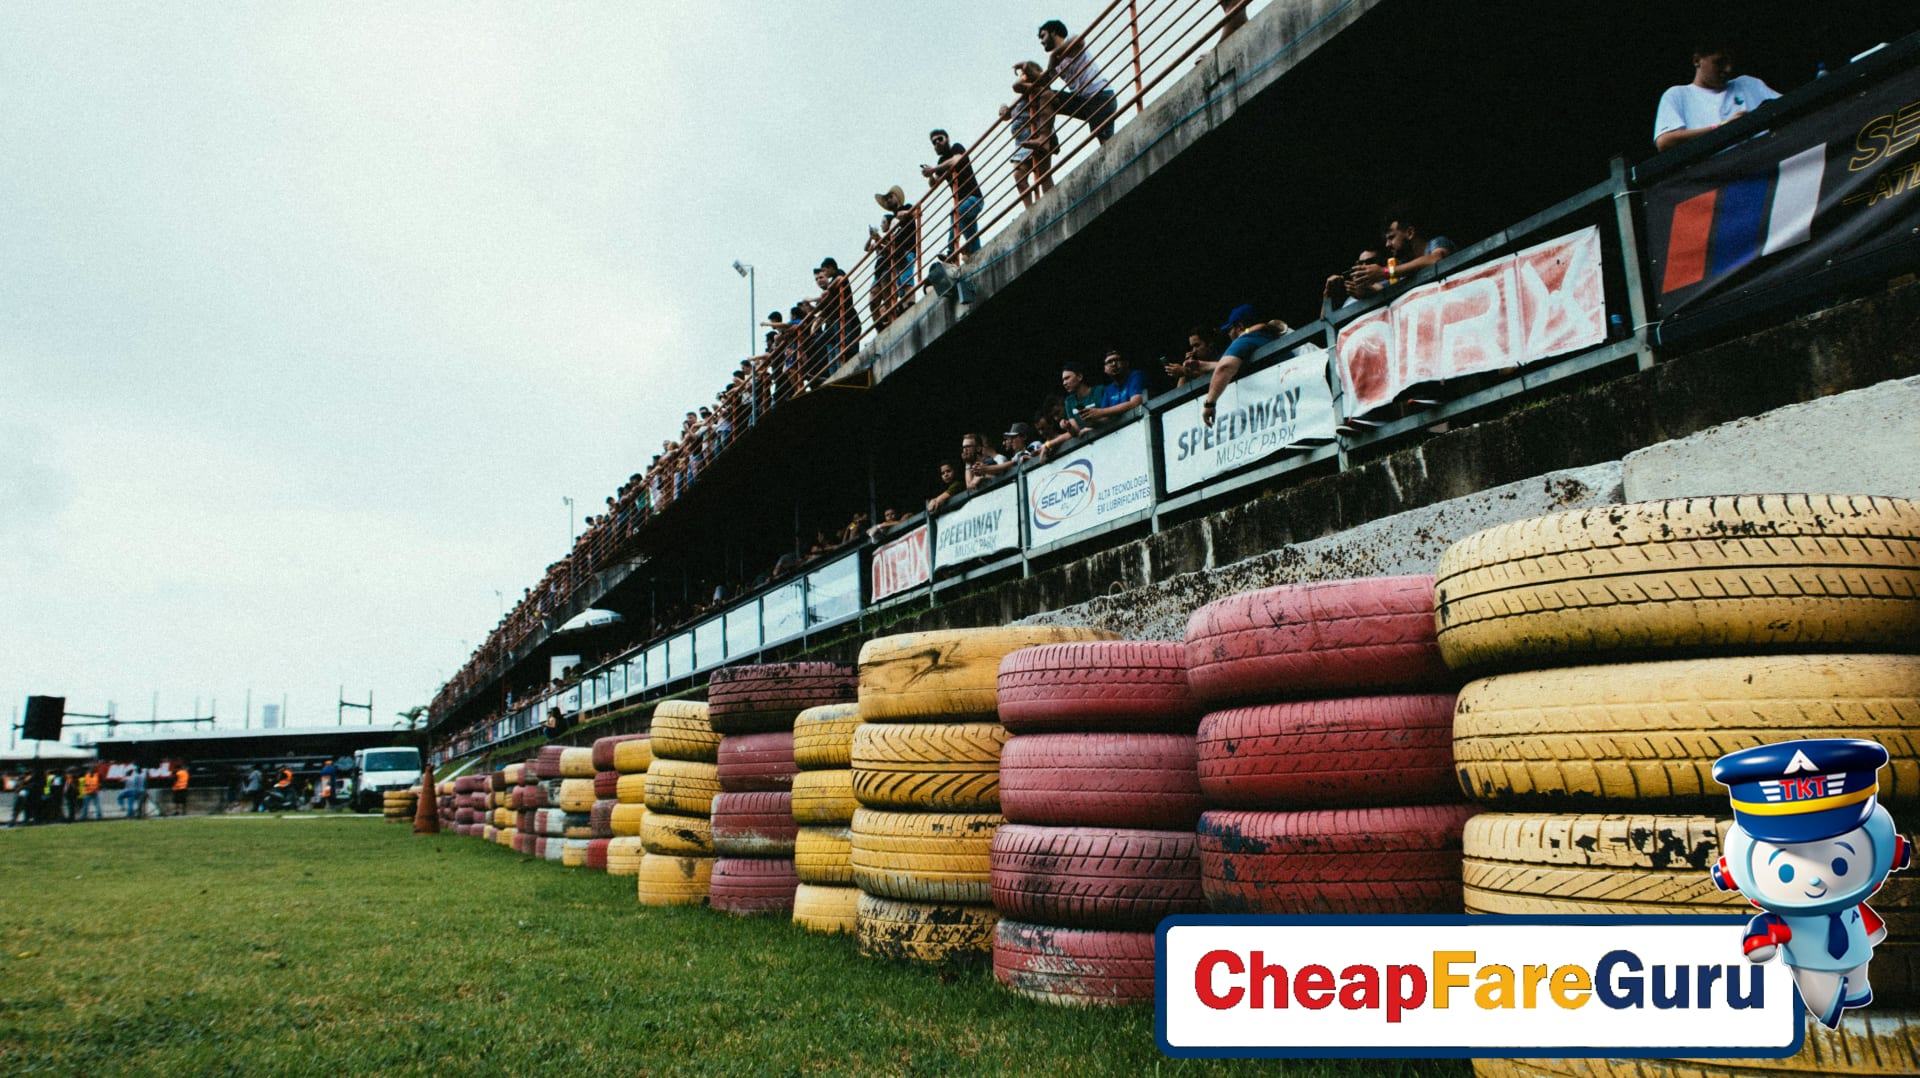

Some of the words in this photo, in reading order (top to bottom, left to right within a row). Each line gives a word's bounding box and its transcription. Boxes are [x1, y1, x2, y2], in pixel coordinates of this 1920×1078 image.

[1178, 386, 1300, 461] SPEEDWAY
[1216, 436, 1257, 467] MUSIC
[1261, 424, 1296, 451] PARK
[1041, 480, 1085, 509] SELMER
[1098, 488, 1110, 501] ALTA
[1112, 473, 1148, 496] TECNOLOGIA
[1106, 486, 1151, 511] LUBRIFICANTES
[938, 509, 1003, 551] SPEEDWAY
[954, 539, 977, 559] MUSIC
[979, 535, 997, 551] PARK
